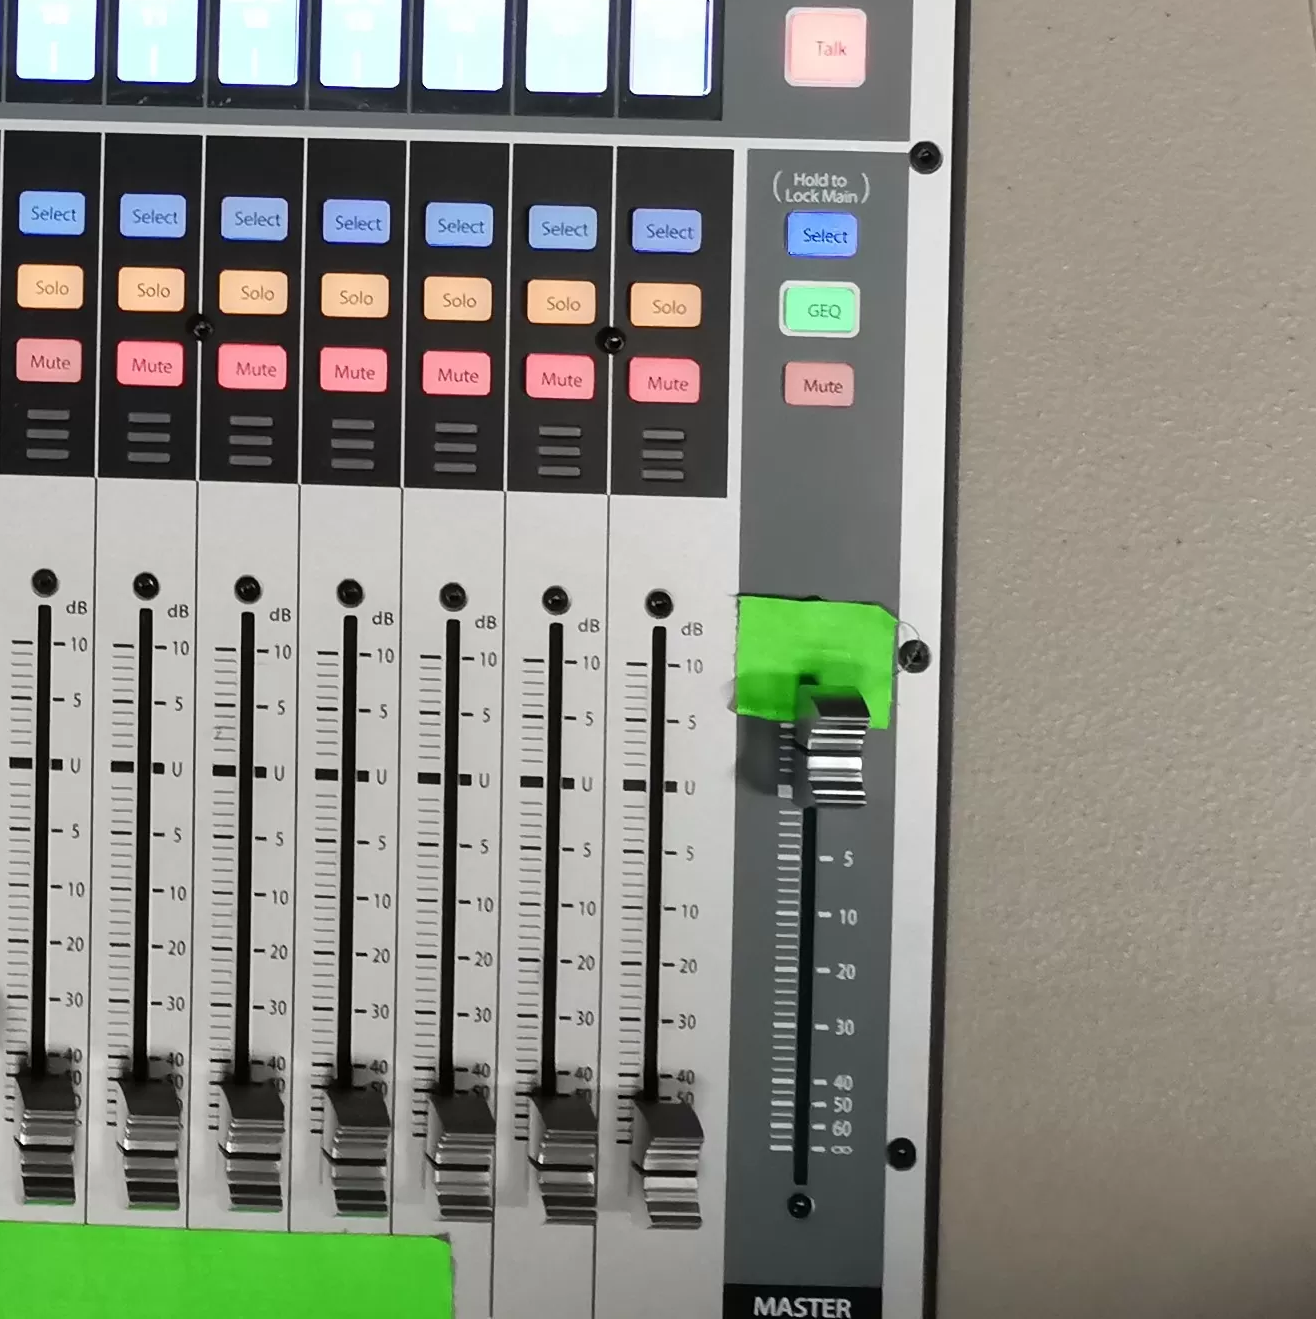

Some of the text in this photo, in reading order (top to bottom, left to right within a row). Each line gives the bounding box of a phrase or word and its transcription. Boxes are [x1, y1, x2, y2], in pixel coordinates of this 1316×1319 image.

[815, 40, 848, 57] Talk
[30, 205, 77, 223] Select
[645, 223, 695, 241] Select
[802, 227, 848, 244] Select
[35, 279, 70, 296] Solo
[651, 299, 688, 316] Solo
[807, 303, 842, 320] GEQ
[30, 354, 71, 370] Mute
[647, 375, 690, 392] Mute
[803, 378, 844, 394] Mute
[835, 962, 857, 981] 20
[753, 1296, 852, 1319] MASTER
